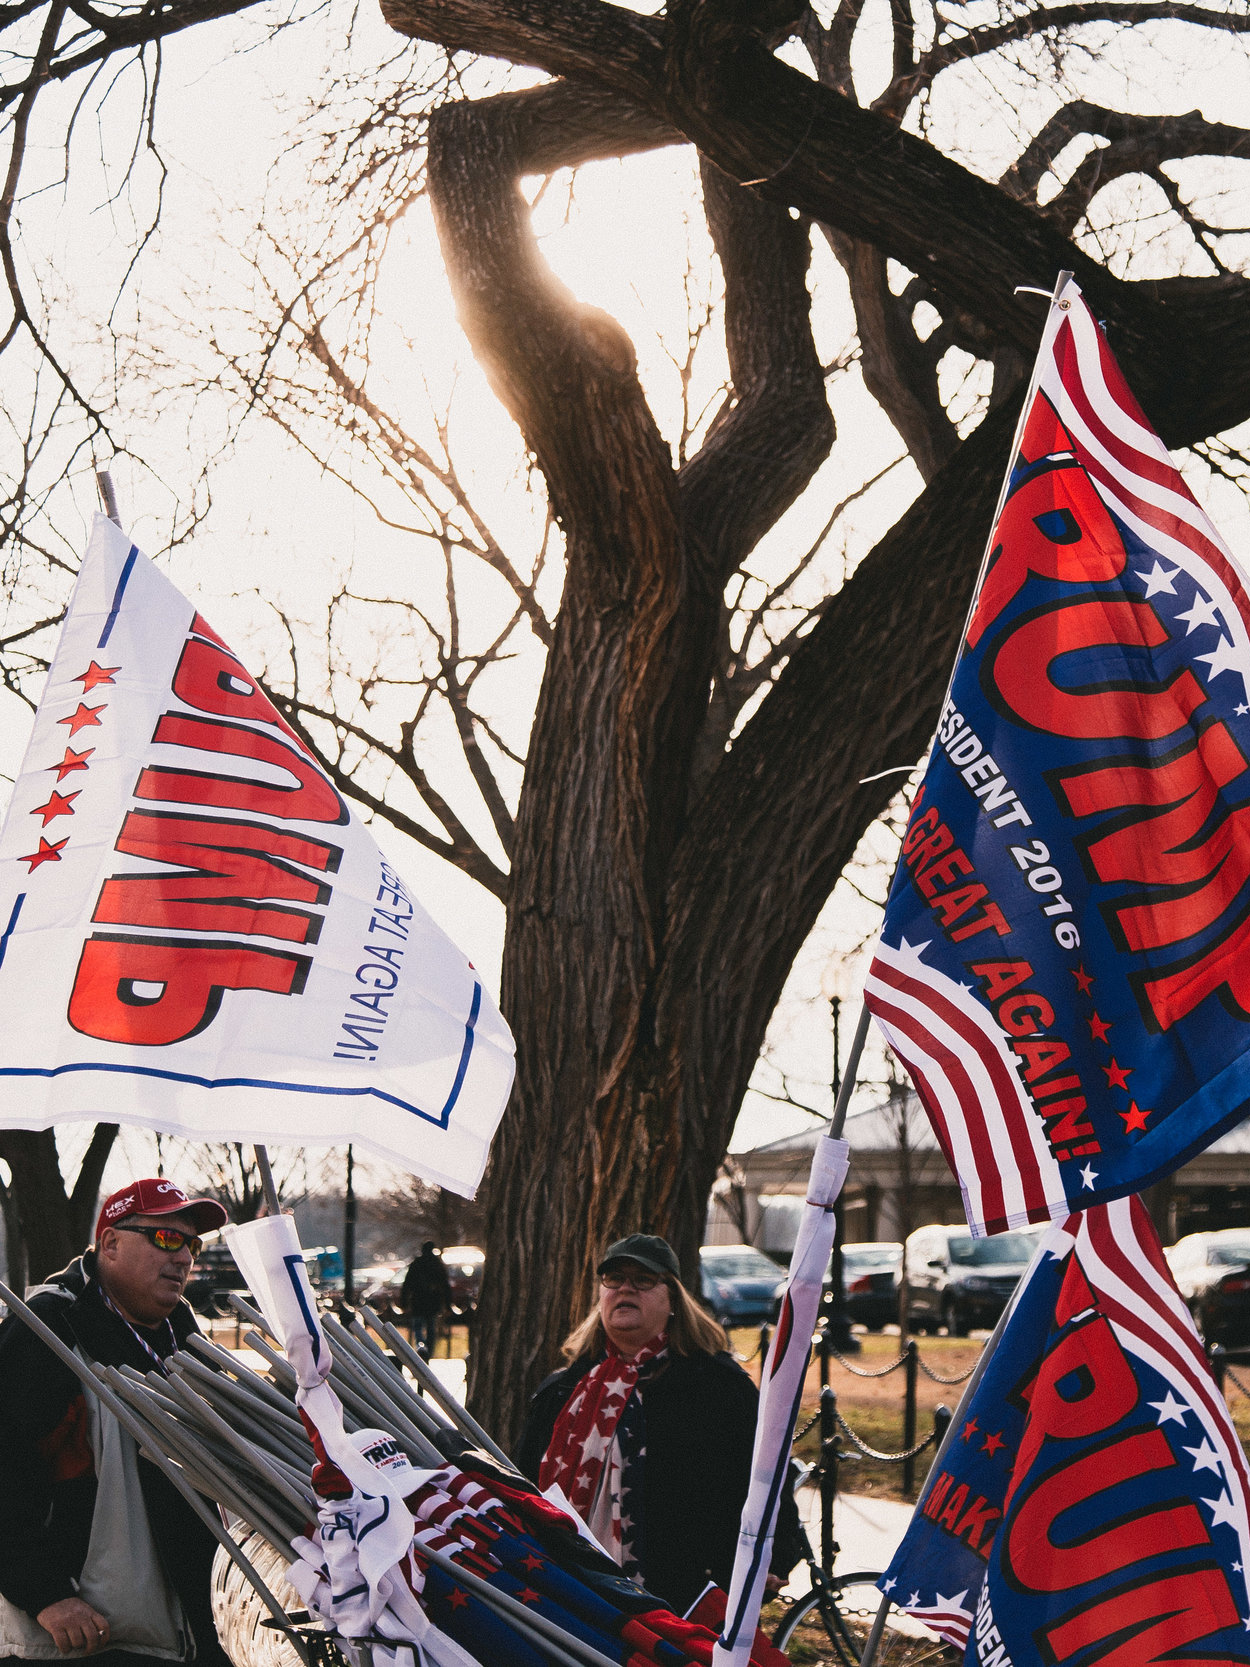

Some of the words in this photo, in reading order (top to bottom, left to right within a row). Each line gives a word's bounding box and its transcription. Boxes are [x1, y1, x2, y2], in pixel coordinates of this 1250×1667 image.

[1010, 840, 1081, 949] 2016
[902, 805, 1012, 944] GREAT
[964, 957, 1102, 1162] AGAIN!
[921, 1471, 1001, 1564] MAK
